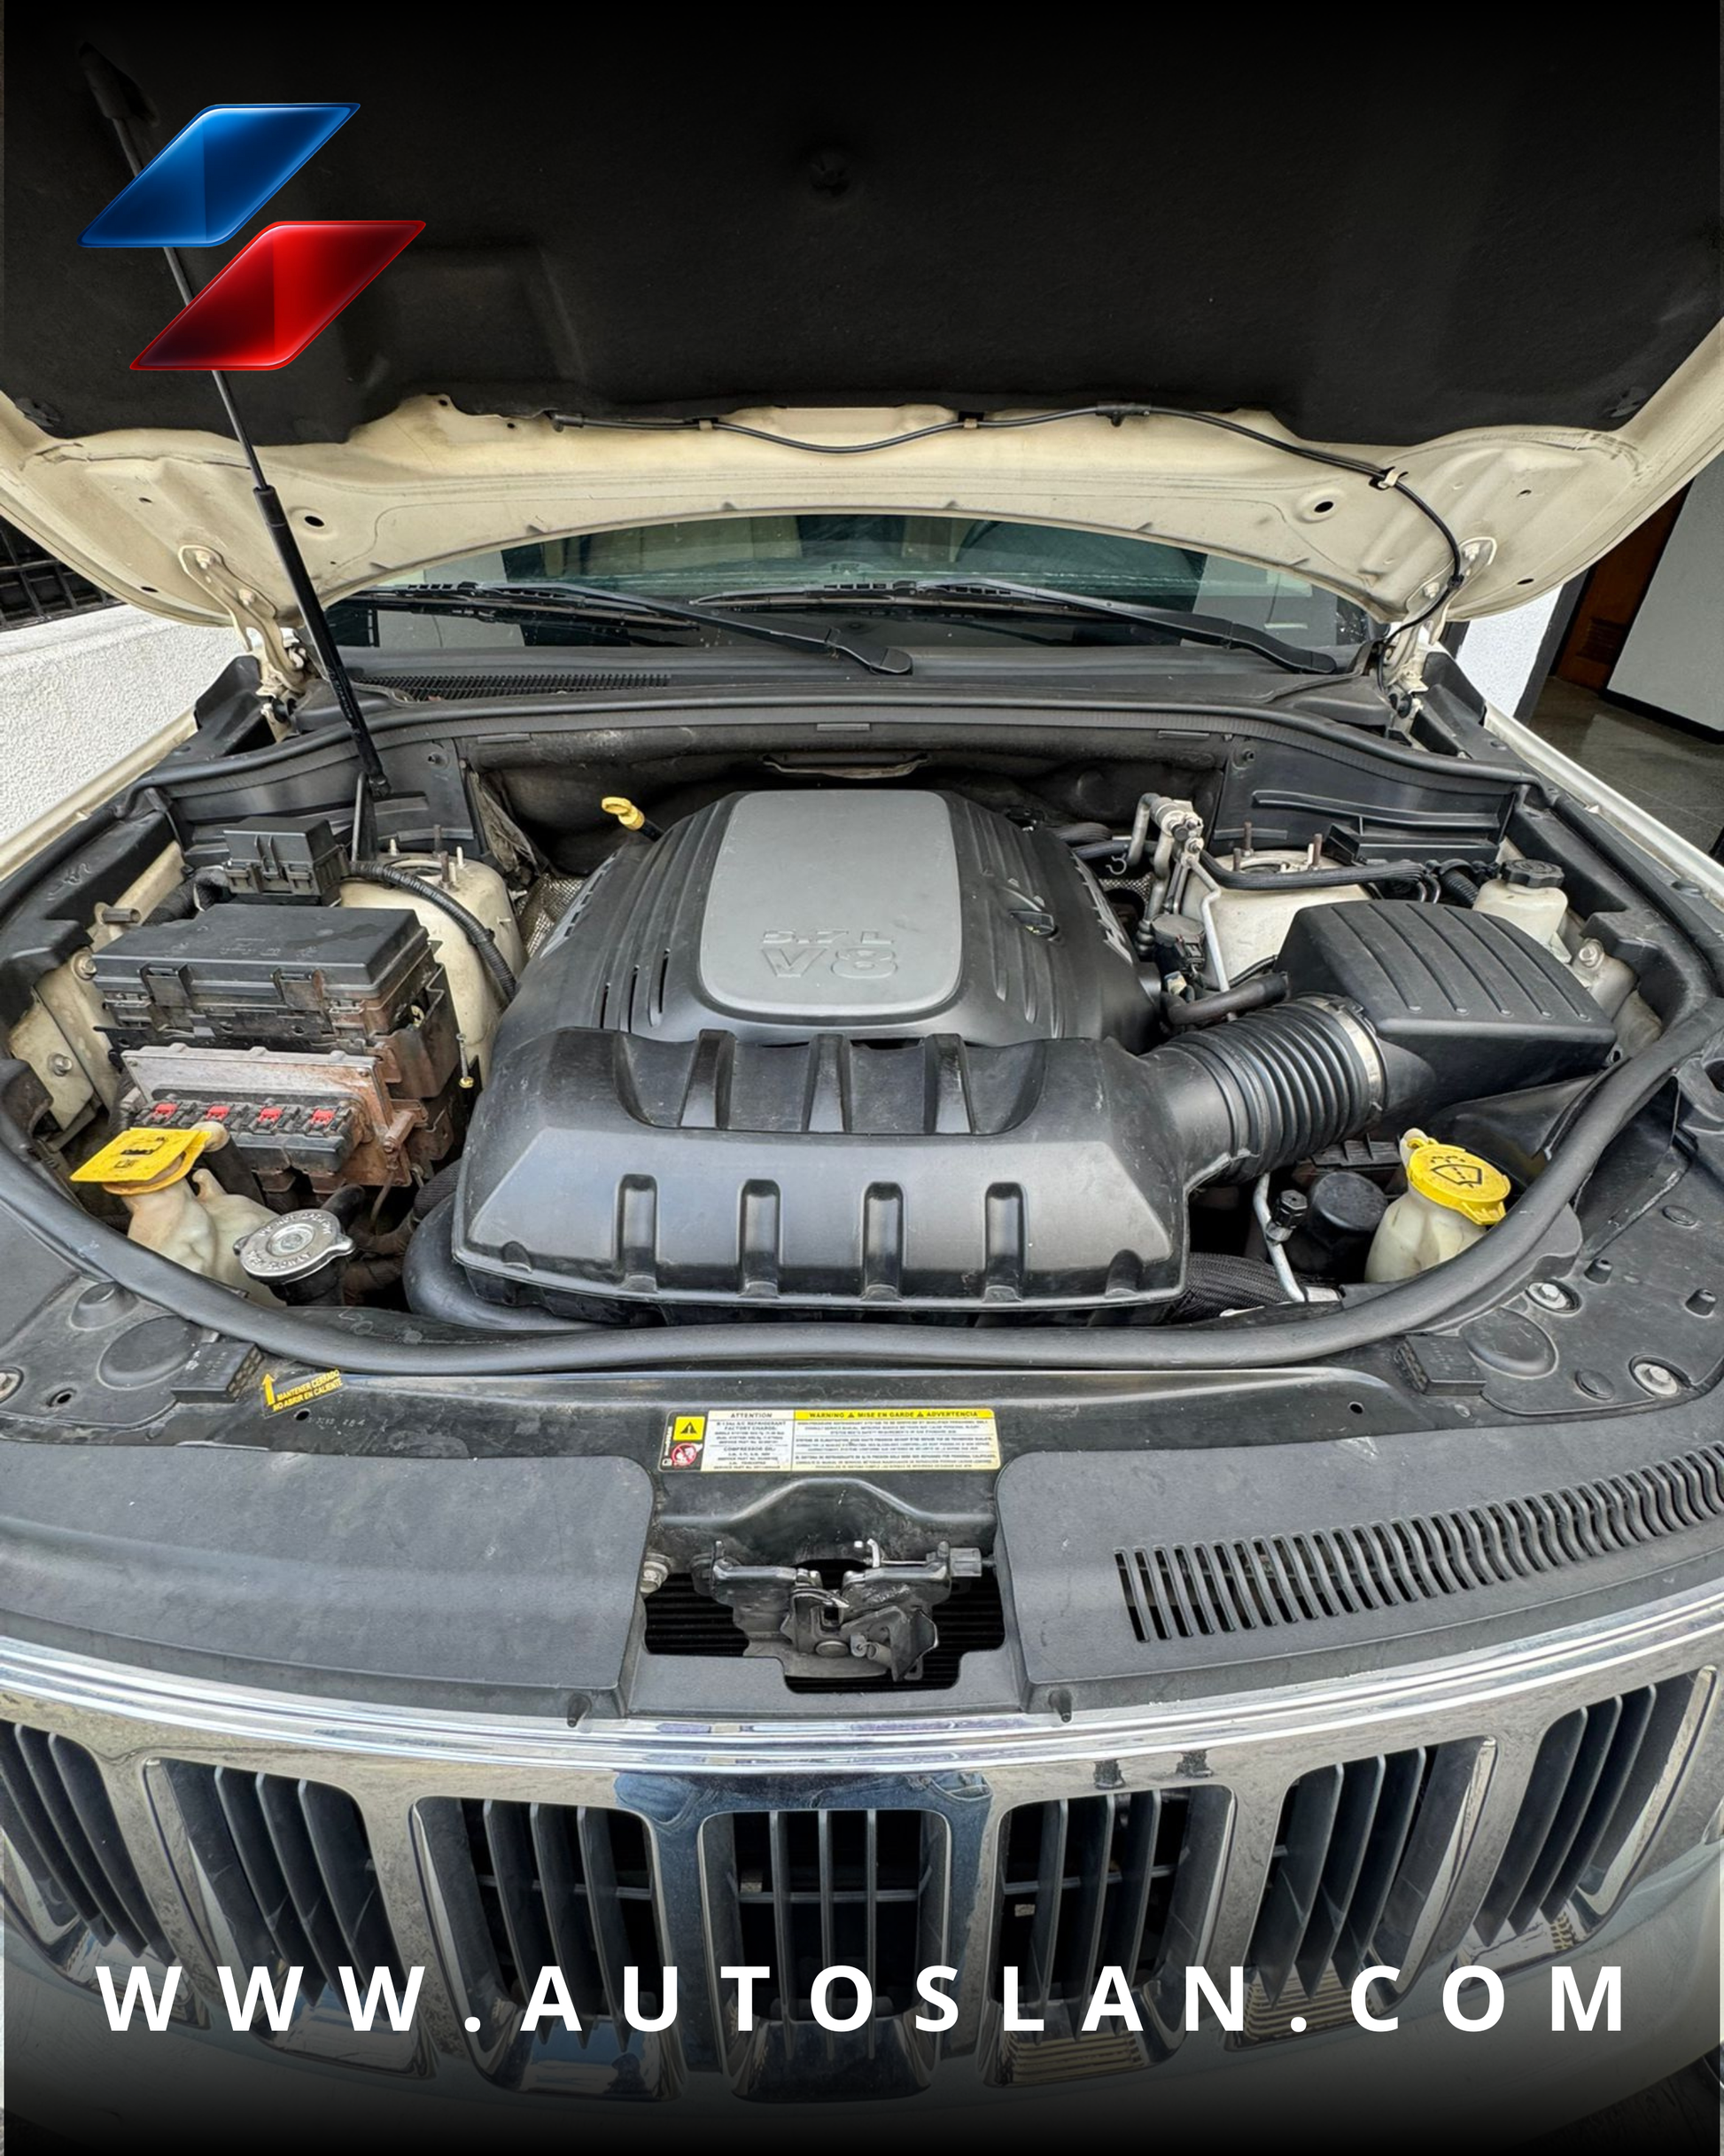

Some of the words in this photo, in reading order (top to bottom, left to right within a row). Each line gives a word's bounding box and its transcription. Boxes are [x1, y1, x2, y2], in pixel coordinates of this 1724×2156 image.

[761, 946, 898, 979] V8
[272, 1403, 283, 1412] NO
[283, 1394, 304, 1407] ABRIR
[304, 1391, 314, 1400] EN
[314, 1377, 343, 1396] CALIENTE
[276, 1382, 312, 1401] MANTENER
[311, 1369, 340, 1389] CERRADO
